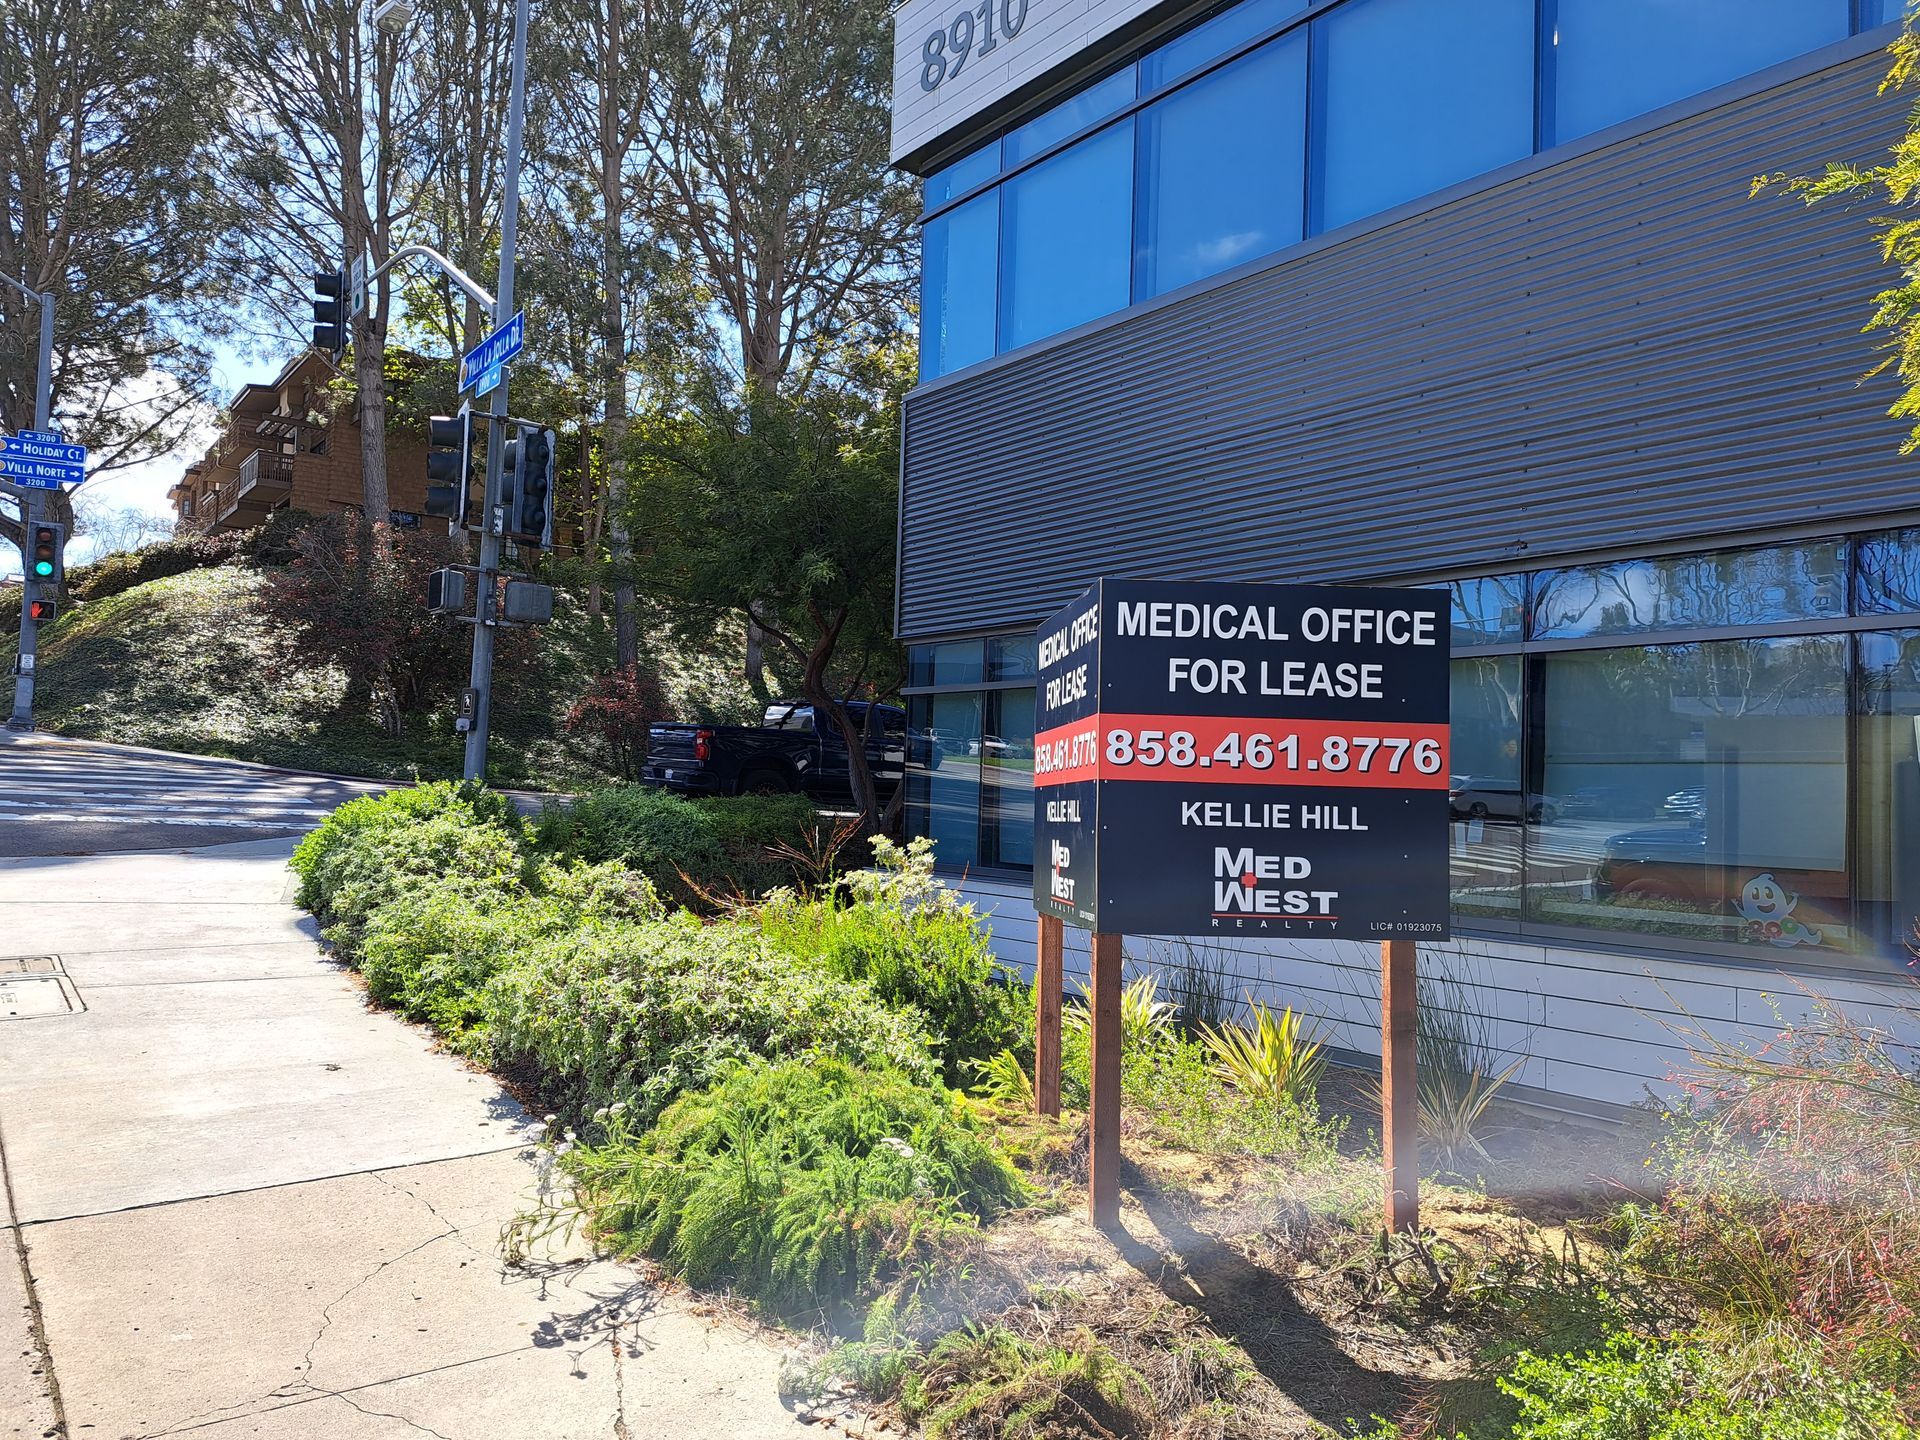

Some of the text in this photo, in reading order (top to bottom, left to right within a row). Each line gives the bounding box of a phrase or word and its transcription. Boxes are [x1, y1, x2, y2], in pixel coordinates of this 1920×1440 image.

[920, 0, 1028, 92] 8910
[23, 443, 82, 460] HOLIDAY CT.
[36, 434, 56, 442] 3200
[7, 461, 66, 478] VILLA NORTE
[25, 478, 46, 487] 3200
[1038, 603, 1098, 671] MEDICAL OFFICE
[1117, 601, 1436, 646] MEDICAL OFFICE
[1046, 664, 1088, 712] FOR LEASE
[1168, 657, 1384, 699] FOR LEASE
[1035, 730, 1097, 775] 858.461.8776
[1105, 729, 1442, 775] 858.461.8776
[1047, 799, 1081, 822] KELLIE HILL
[1181, 801, 1369, 831] KELLIE HILL
[1051, 839, 1071, 868] MED
[1214, 846, 1312, 879] MED
[1051, 868, 1075, 900] WEST
[1214, 880, 1339, 915] WEST
[1211, 918, 1338, 930] REALTY
[1370, 922, 1442, 932] LIC# 01923075
